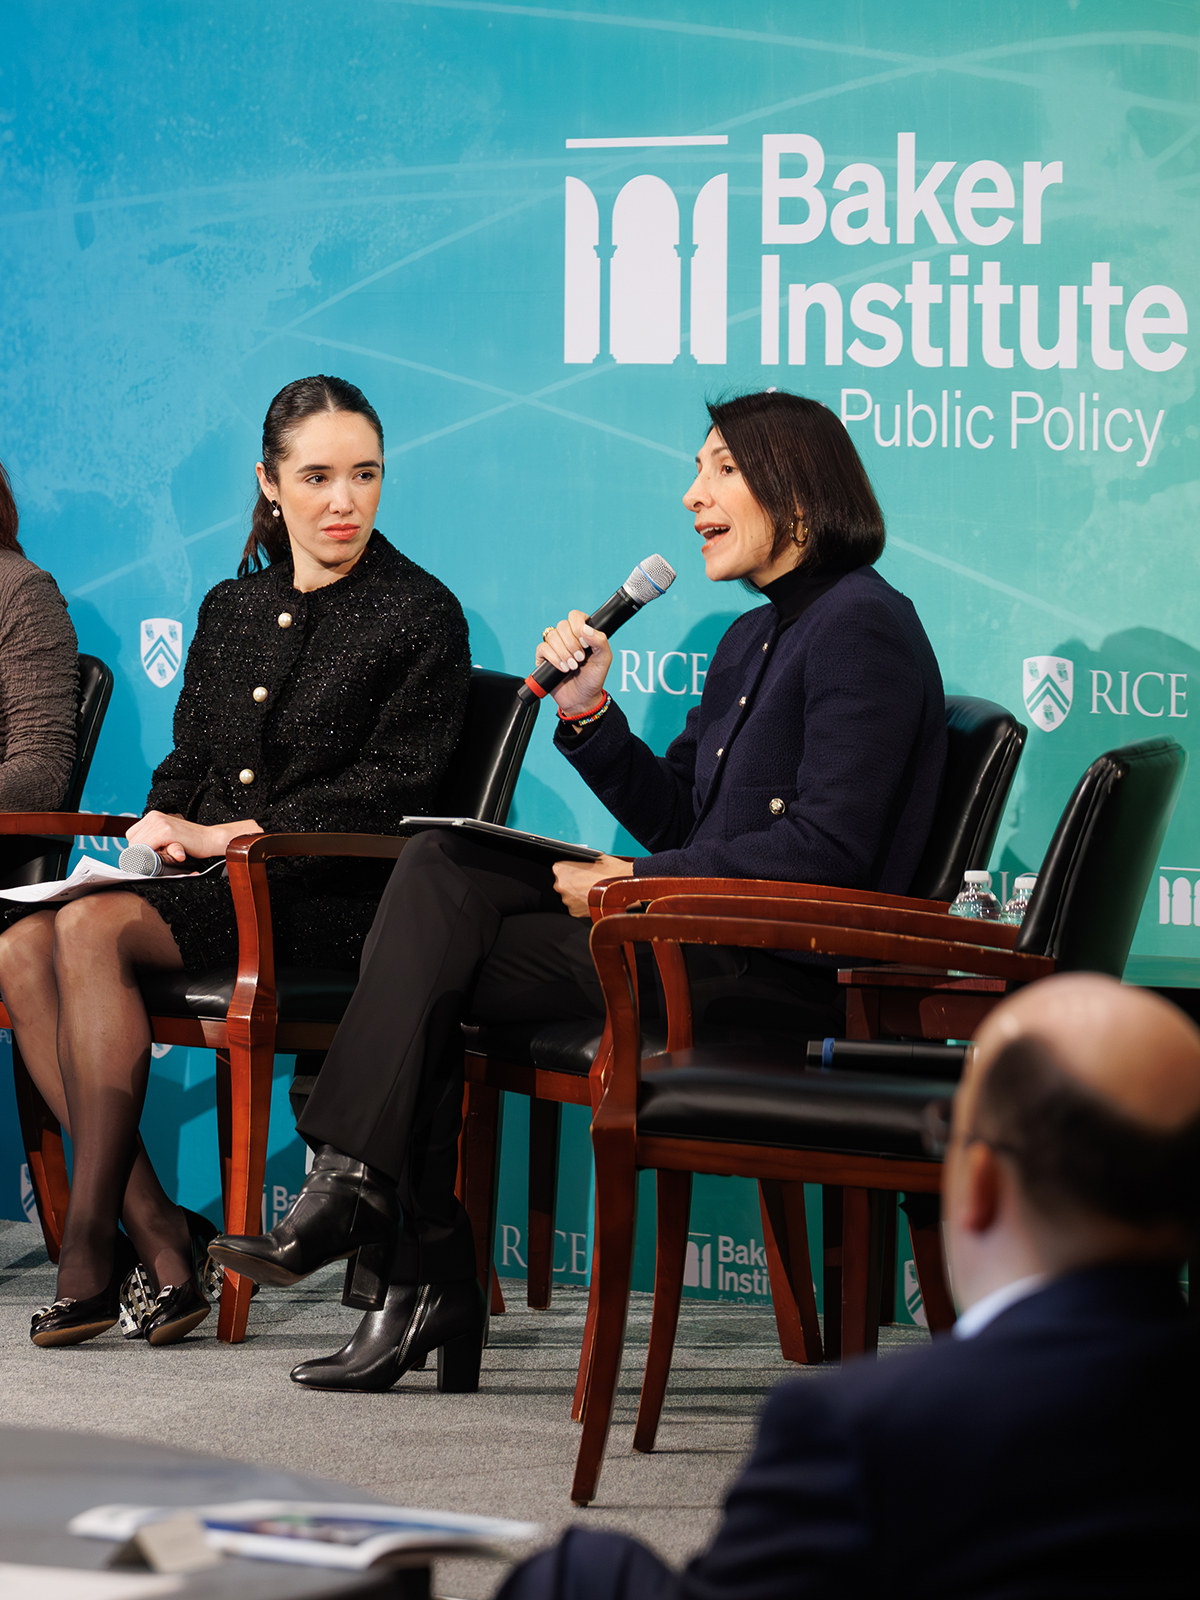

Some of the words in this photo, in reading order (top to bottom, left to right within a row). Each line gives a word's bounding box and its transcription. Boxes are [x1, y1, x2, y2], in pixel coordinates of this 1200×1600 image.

[761, 132, 1063, 246] Baker
[759, 254, 1188, 372] Institute
[841, 388, 995, 449] Public
[1011, 391, 1165, 467] Policy
[619, 649, 708, 696] RICE
[1089, 669, 1188, 718] RICE
